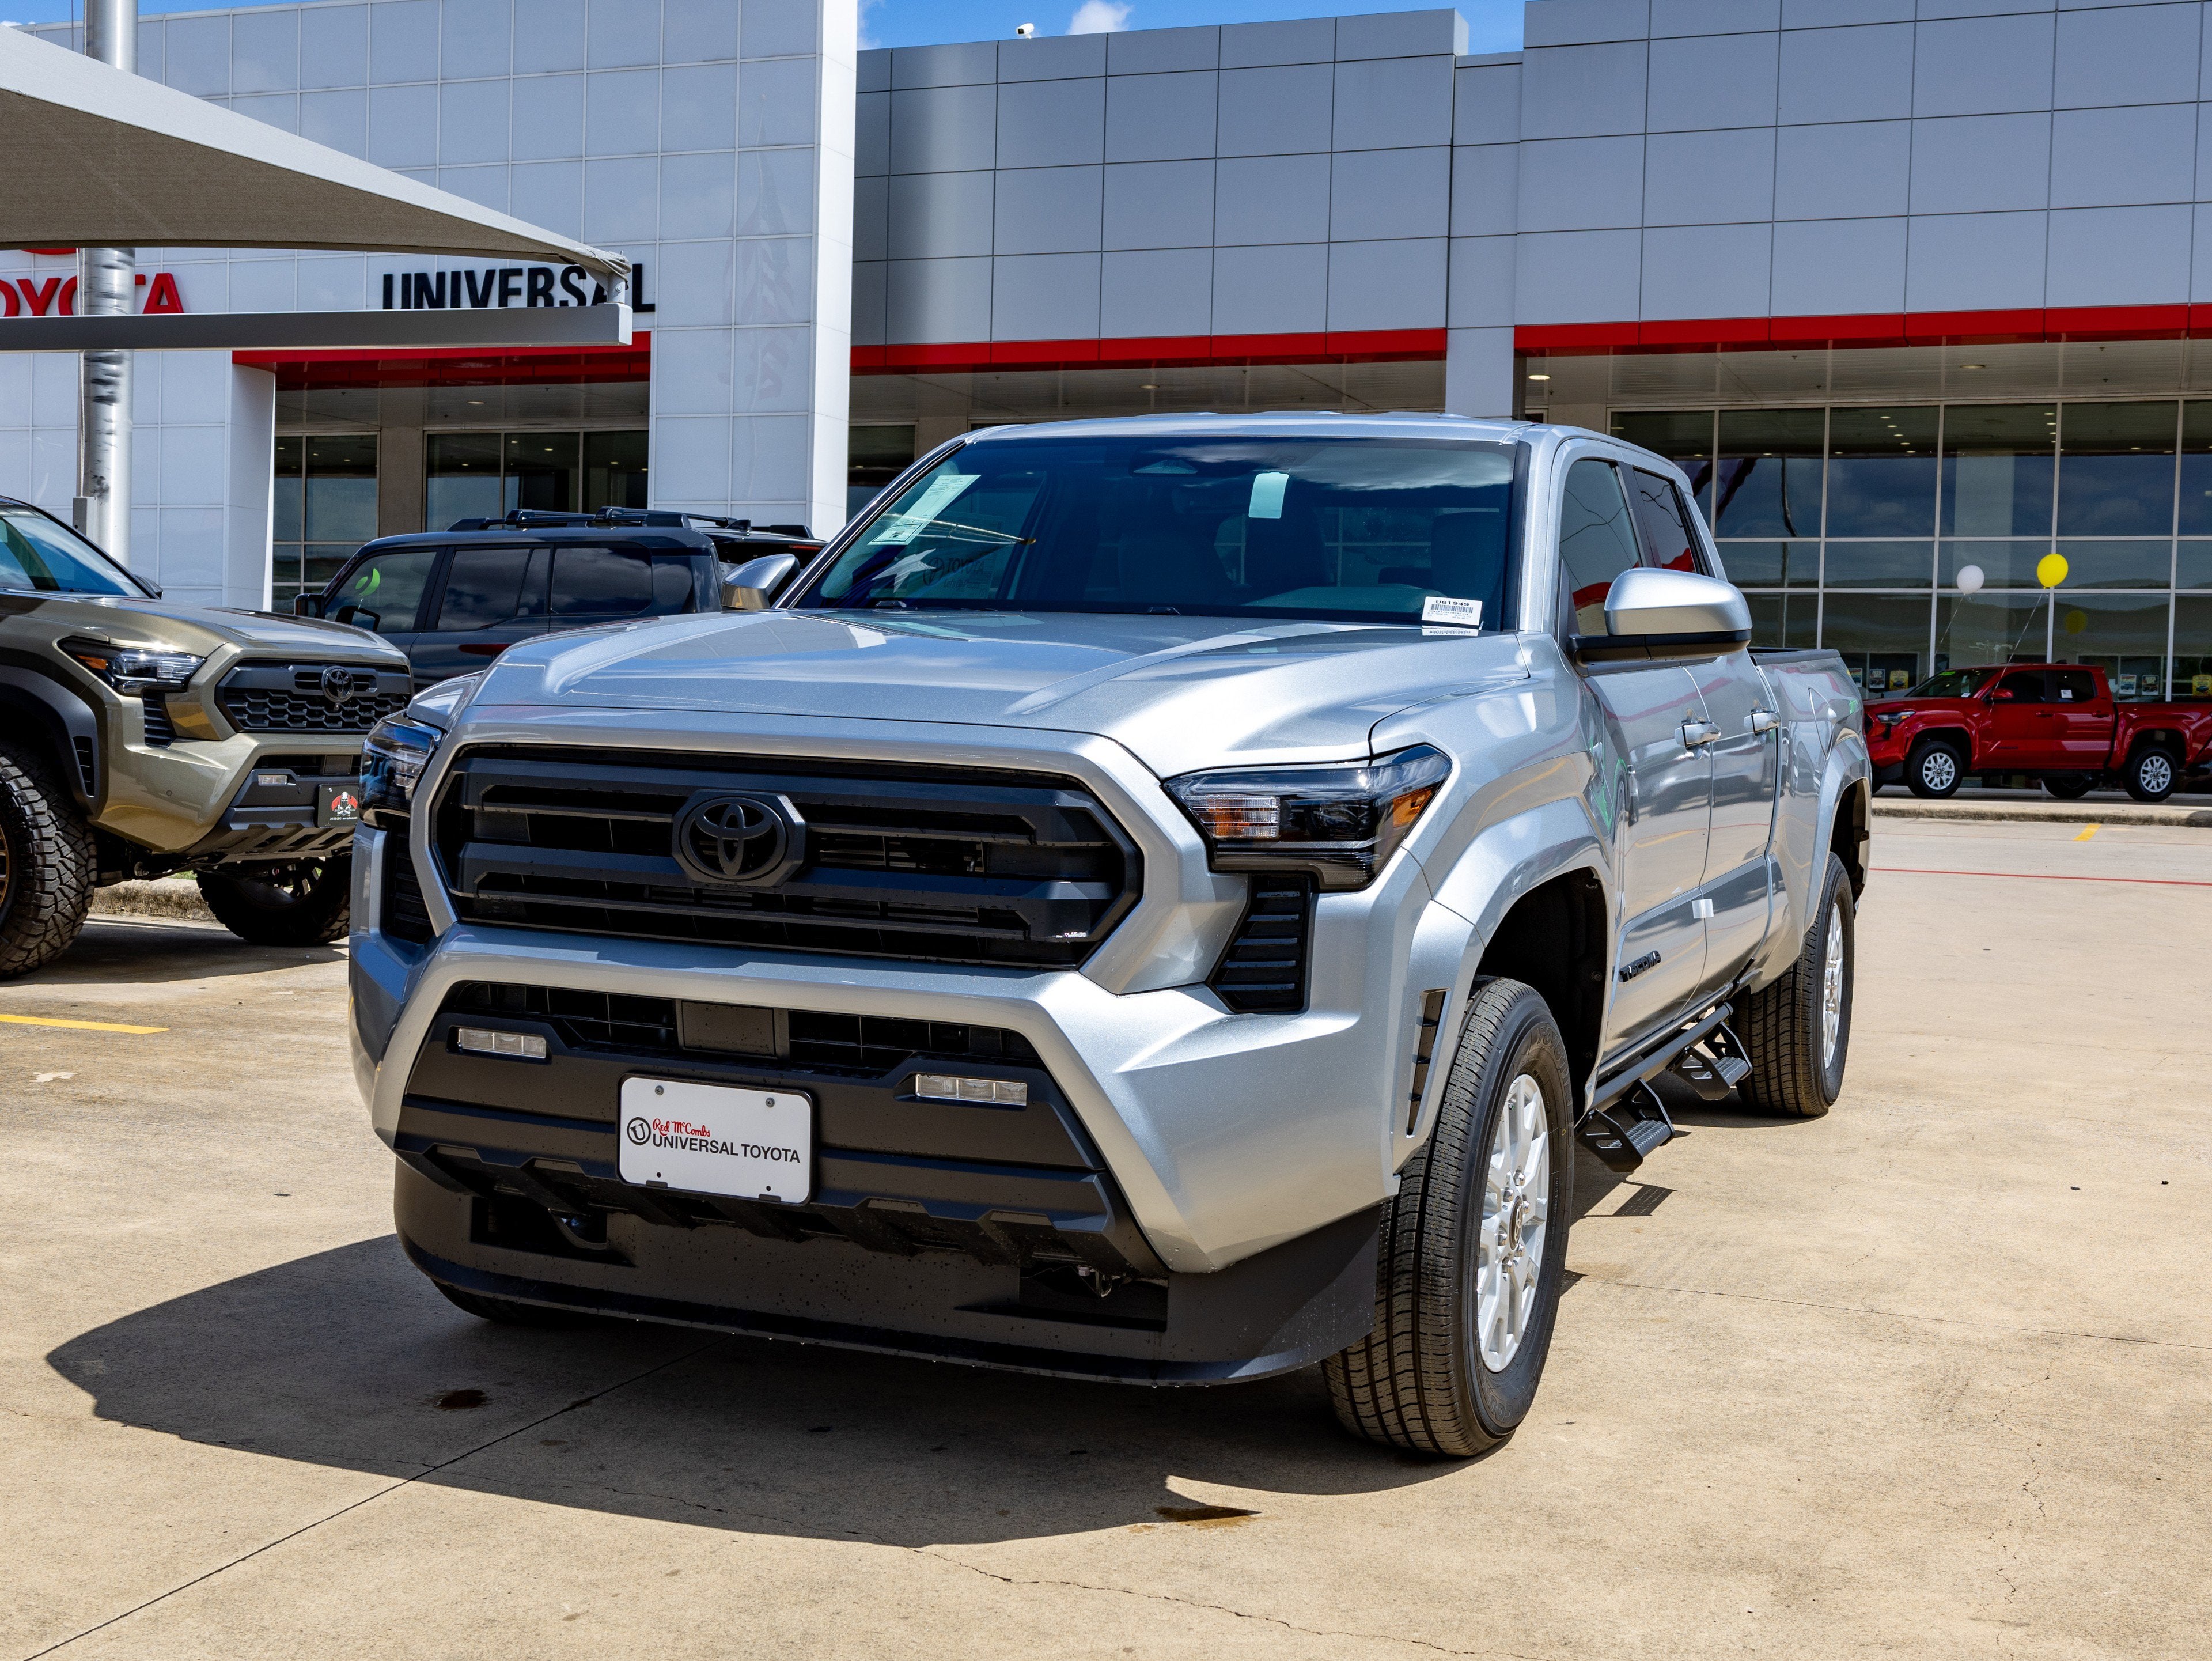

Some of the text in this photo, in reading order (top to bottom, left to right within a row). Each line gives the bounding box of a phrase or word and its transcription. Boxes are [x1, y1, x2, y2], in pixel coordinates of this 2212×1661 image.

[383, 263, 656, 312] UNIVERSL
[653, 1118, 710, 1137] Red McCombs
[653, 1133, 801, 1163] UNIVERSAL TOYOTA
